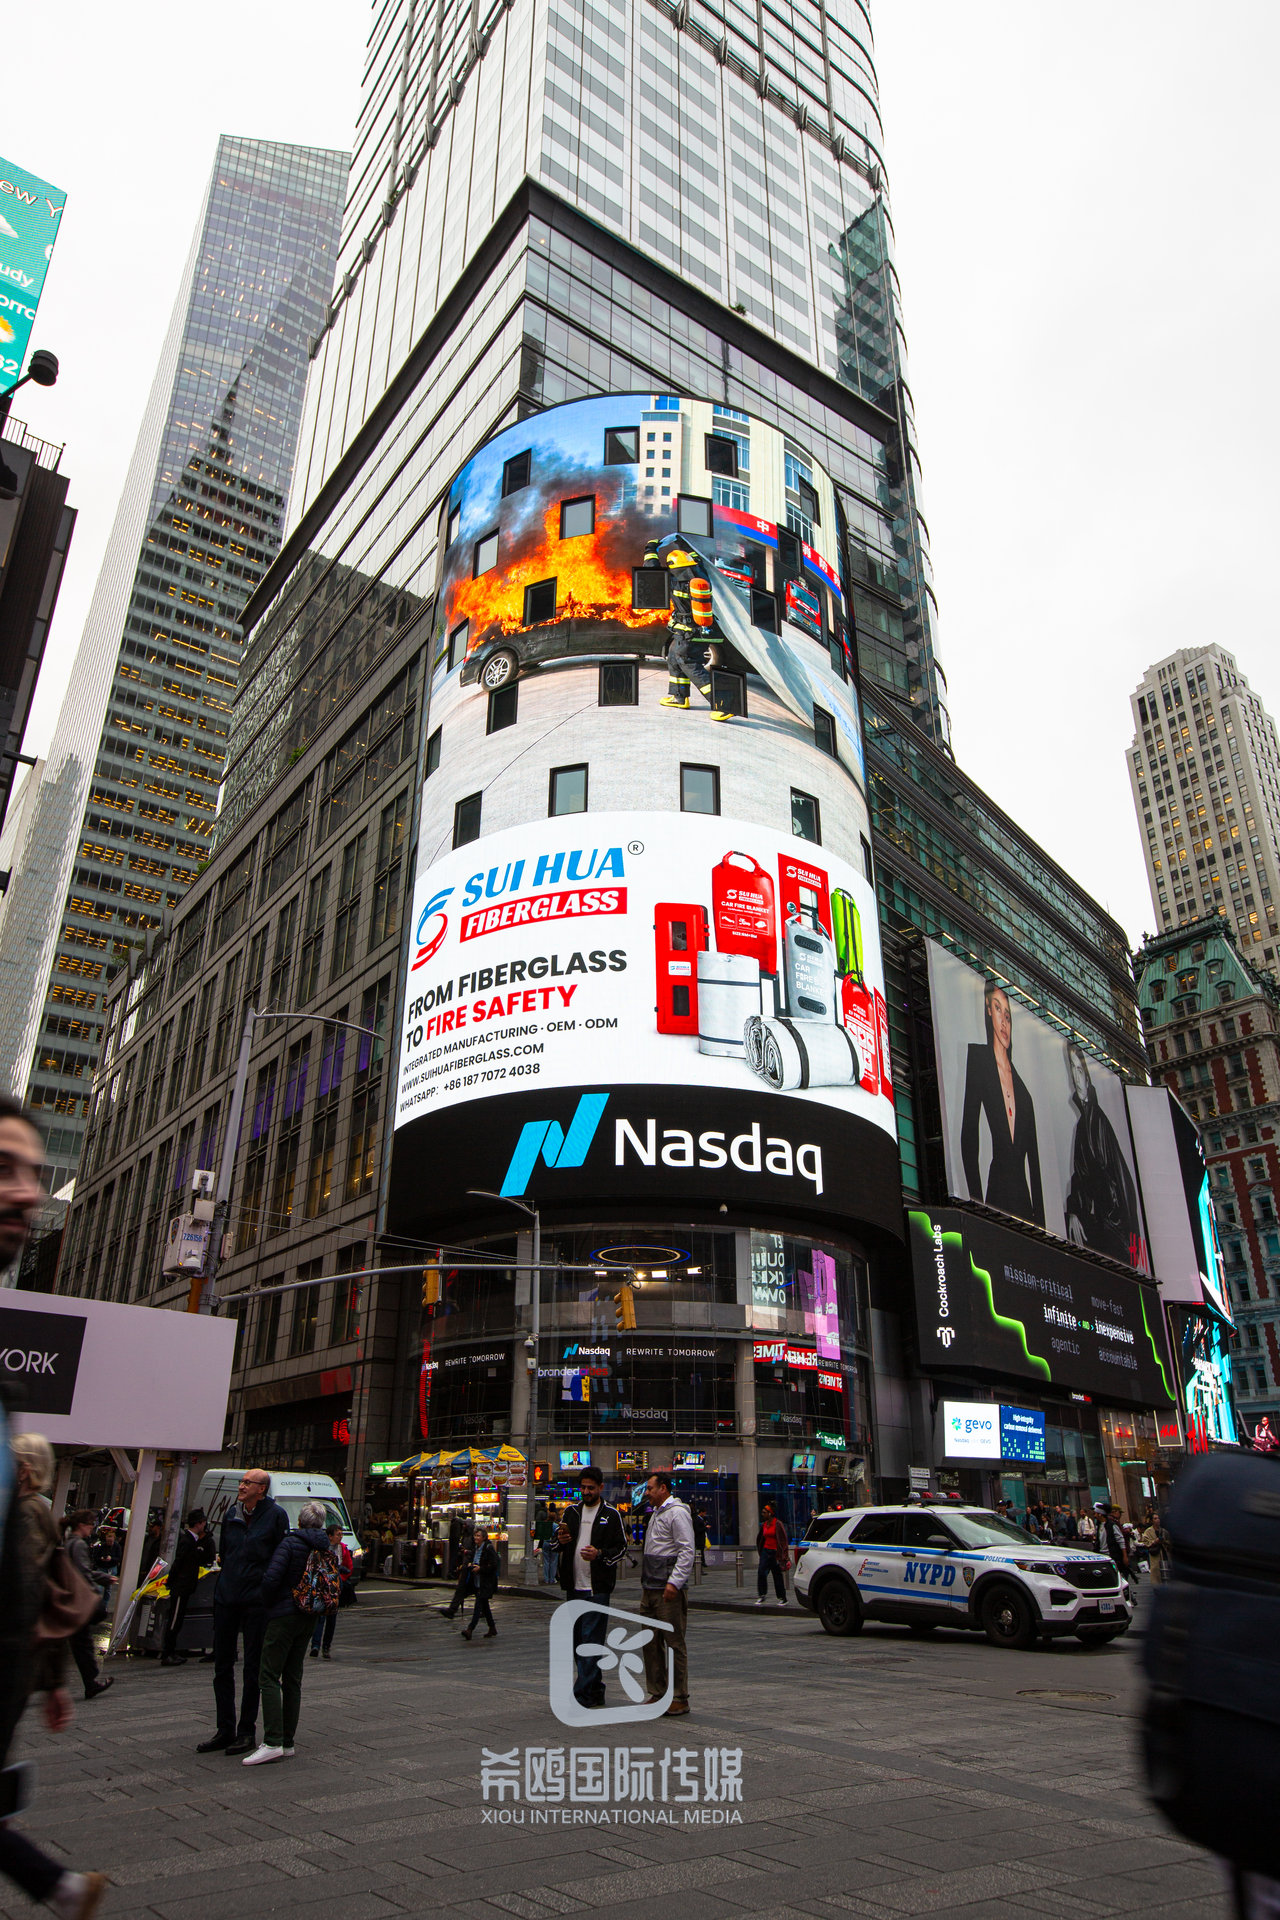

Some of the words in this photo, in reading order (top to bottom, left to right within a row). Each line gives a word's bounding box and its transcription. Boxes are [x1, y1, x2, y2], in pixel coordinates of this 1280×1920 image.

[0, 180, 38, 206] ew
[462, 859, 526, 907] SUI
[532, 847, 625, 887] HUA
[465, 890, 620, 938] FIBERGLASS
[795, 963, 810, 972] CAR
[408, 980, 454, 1024] FROM
[458, 950, 628, 997] FIBERGLASS
[406, 1025, 424, 1053] TO
[426, 1005, 467, 1041] FIRE
[472, 984, 578, 1023] SAFETY
[403, 1048, 442, 1076] INTEGRATED
[443, 1024, 538, 1055] MANUFACTURING
[546, 1020, 576, 1033] OEM
[585, 1018, 618, 1030] ODM
[401, 1043, 544, 1094] WWW.SUIHUAFIBERGLASS.COM
[400, 1086, 440, 1113] WHATSAPP:
[443, 1078, 461, 1092] +86
[463, 1074, 479, 1087] 187
[480, 1068, 507, 1083] 7072
[508, 1063, 541, 1077] 4038
[614, 1118, 824, 1196] Nasdaq
[933, 1224, 943, 1252] Labs
[934, 1254, 949, 1317] Cockroach
[1003, 1264, 1073, 1301] mission-critical
[1091, 1296, 1124, 1317] move-fast
[1043, 1303, 1077, 1330] infinite
[1094, 1317, 1135, 1344] inexpensive
[579, 1347, 611, 1357] Nasdaq
[626, 1348, 664, 1356] REWRITE
[667, 1349, 716, 1357] TOMORROW
[1051, 1337, 1080, 1355] agentic
[1098, 1347, 1138, 1370] accountable
[445, 1357, 467, 1367] REWRITE
[469, 1353, 505, 1363] TOMORROW
[538, 1365, 609, 1377] brandedcities
[818, 1359, 839, 1369] REWRITE
[623, 1407, 668, 1421] Nasdaq
[782, 1414, 802, 1425] Nasdaq
[965, 1419, 992, 1433] gevo
[984, 1555, 1007, 1563] POLICE
[904, 1561, 956, 1587] NYPD
